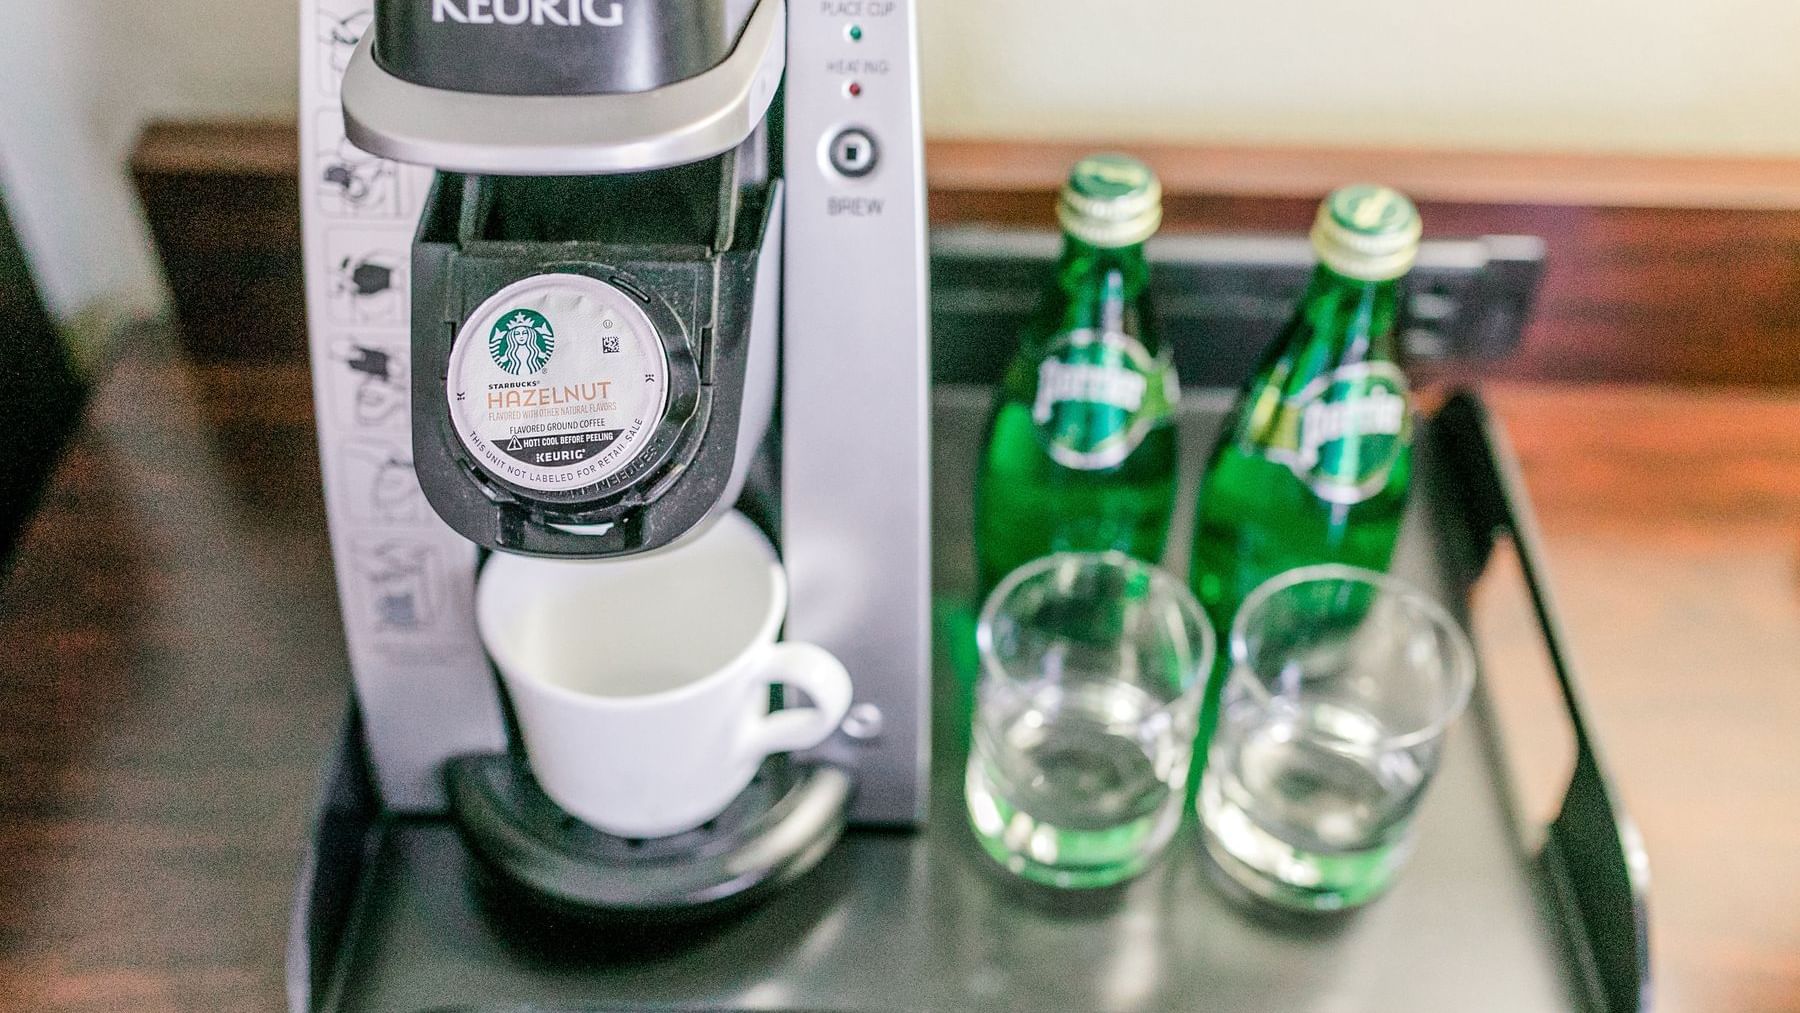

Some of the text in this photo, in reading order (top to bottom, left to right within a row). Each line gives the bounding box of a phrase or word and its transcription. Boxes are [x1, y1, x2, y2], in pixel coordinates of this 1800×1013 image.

[431, 0, 624, 26] KEURIG
[826, 196, 886, 216] BREW
[488, 380, 538, 390] STARBUCKS
[488, 381, 611, 409] HAZELNUT
[488, 401, 617, 421] FLAVORED WITH OTHER NATURAL FLAVORS
[509, 418, 606, 434] FLAVORED GROUND COFFEE
[523, 432, 614, 448] HOT! COOL BEFORE PEELING
[469, 418, 643, 483] THIS UNIT NOT LABELED FOR RETAIL SALE
[536, 450, 583, 462] KEURIG
